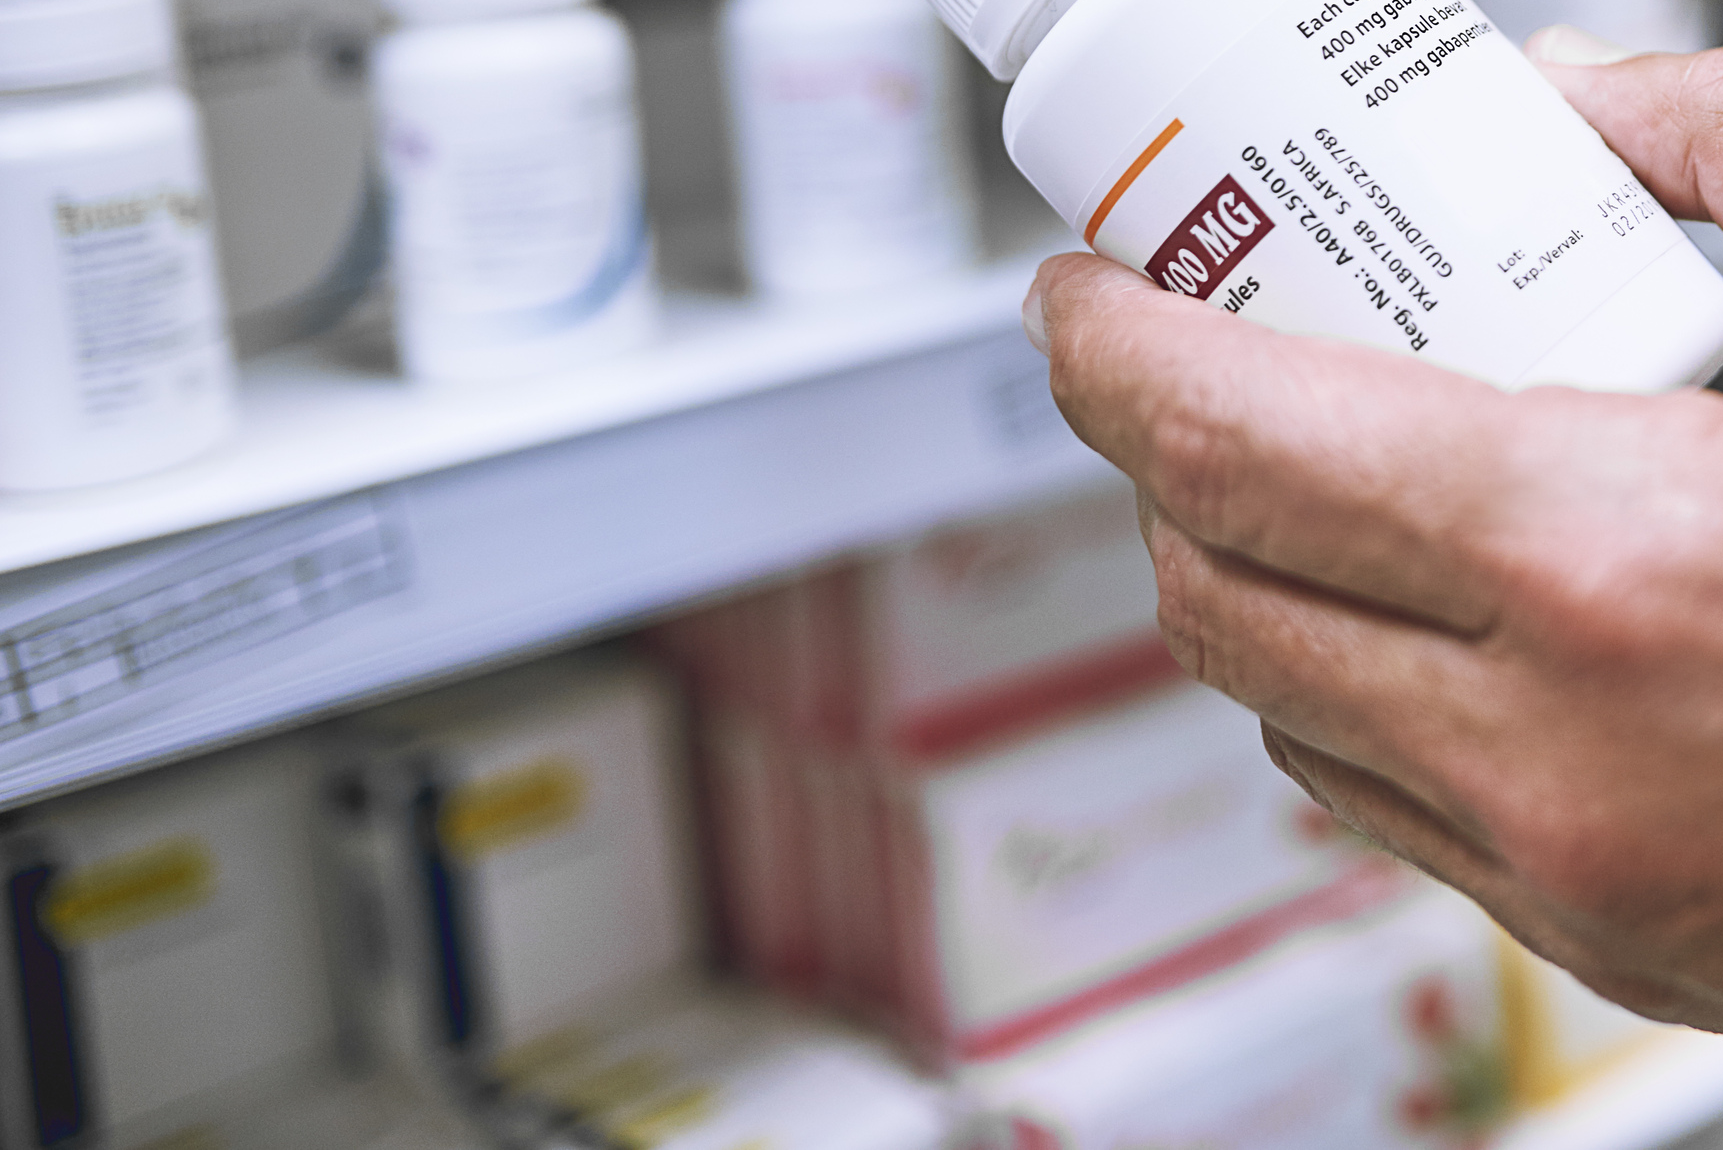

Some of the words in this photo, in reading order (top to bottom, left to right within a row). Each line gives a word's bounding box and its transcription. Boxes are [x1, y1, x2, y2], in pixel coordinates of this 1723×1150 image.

[1297, 2, 1343, 39] Each
[1321, 30, 1355, 60] 400
[1355, 10, 1386, 36] mg
[1340, 54, 1382, 87] Elke
[1377, 15, 1440, 58] kapsule
[1365, 78, 1399, 109] 400
[1398, 58, 1430, 84] mg
[1282, 139, 1351, 215] S.AFRICA
[1314, 128, 1453, 278] GUJ/DRUGS/25/789
[1189, 191, 1261, 266] MG
[1241, 145, 1354, 266] A40/2.5/0160
[1353, 220, 1438, 312] PXLB0176B
[1497, 249, 1525, 273] Lot:
[1512, 229, 1584, 290] Exp./Verval:
[1223, 276, 1260, 313] ules
[1354, 267, 1391, 310] No.:
[1393, 305, 1429, 352] Reg.
